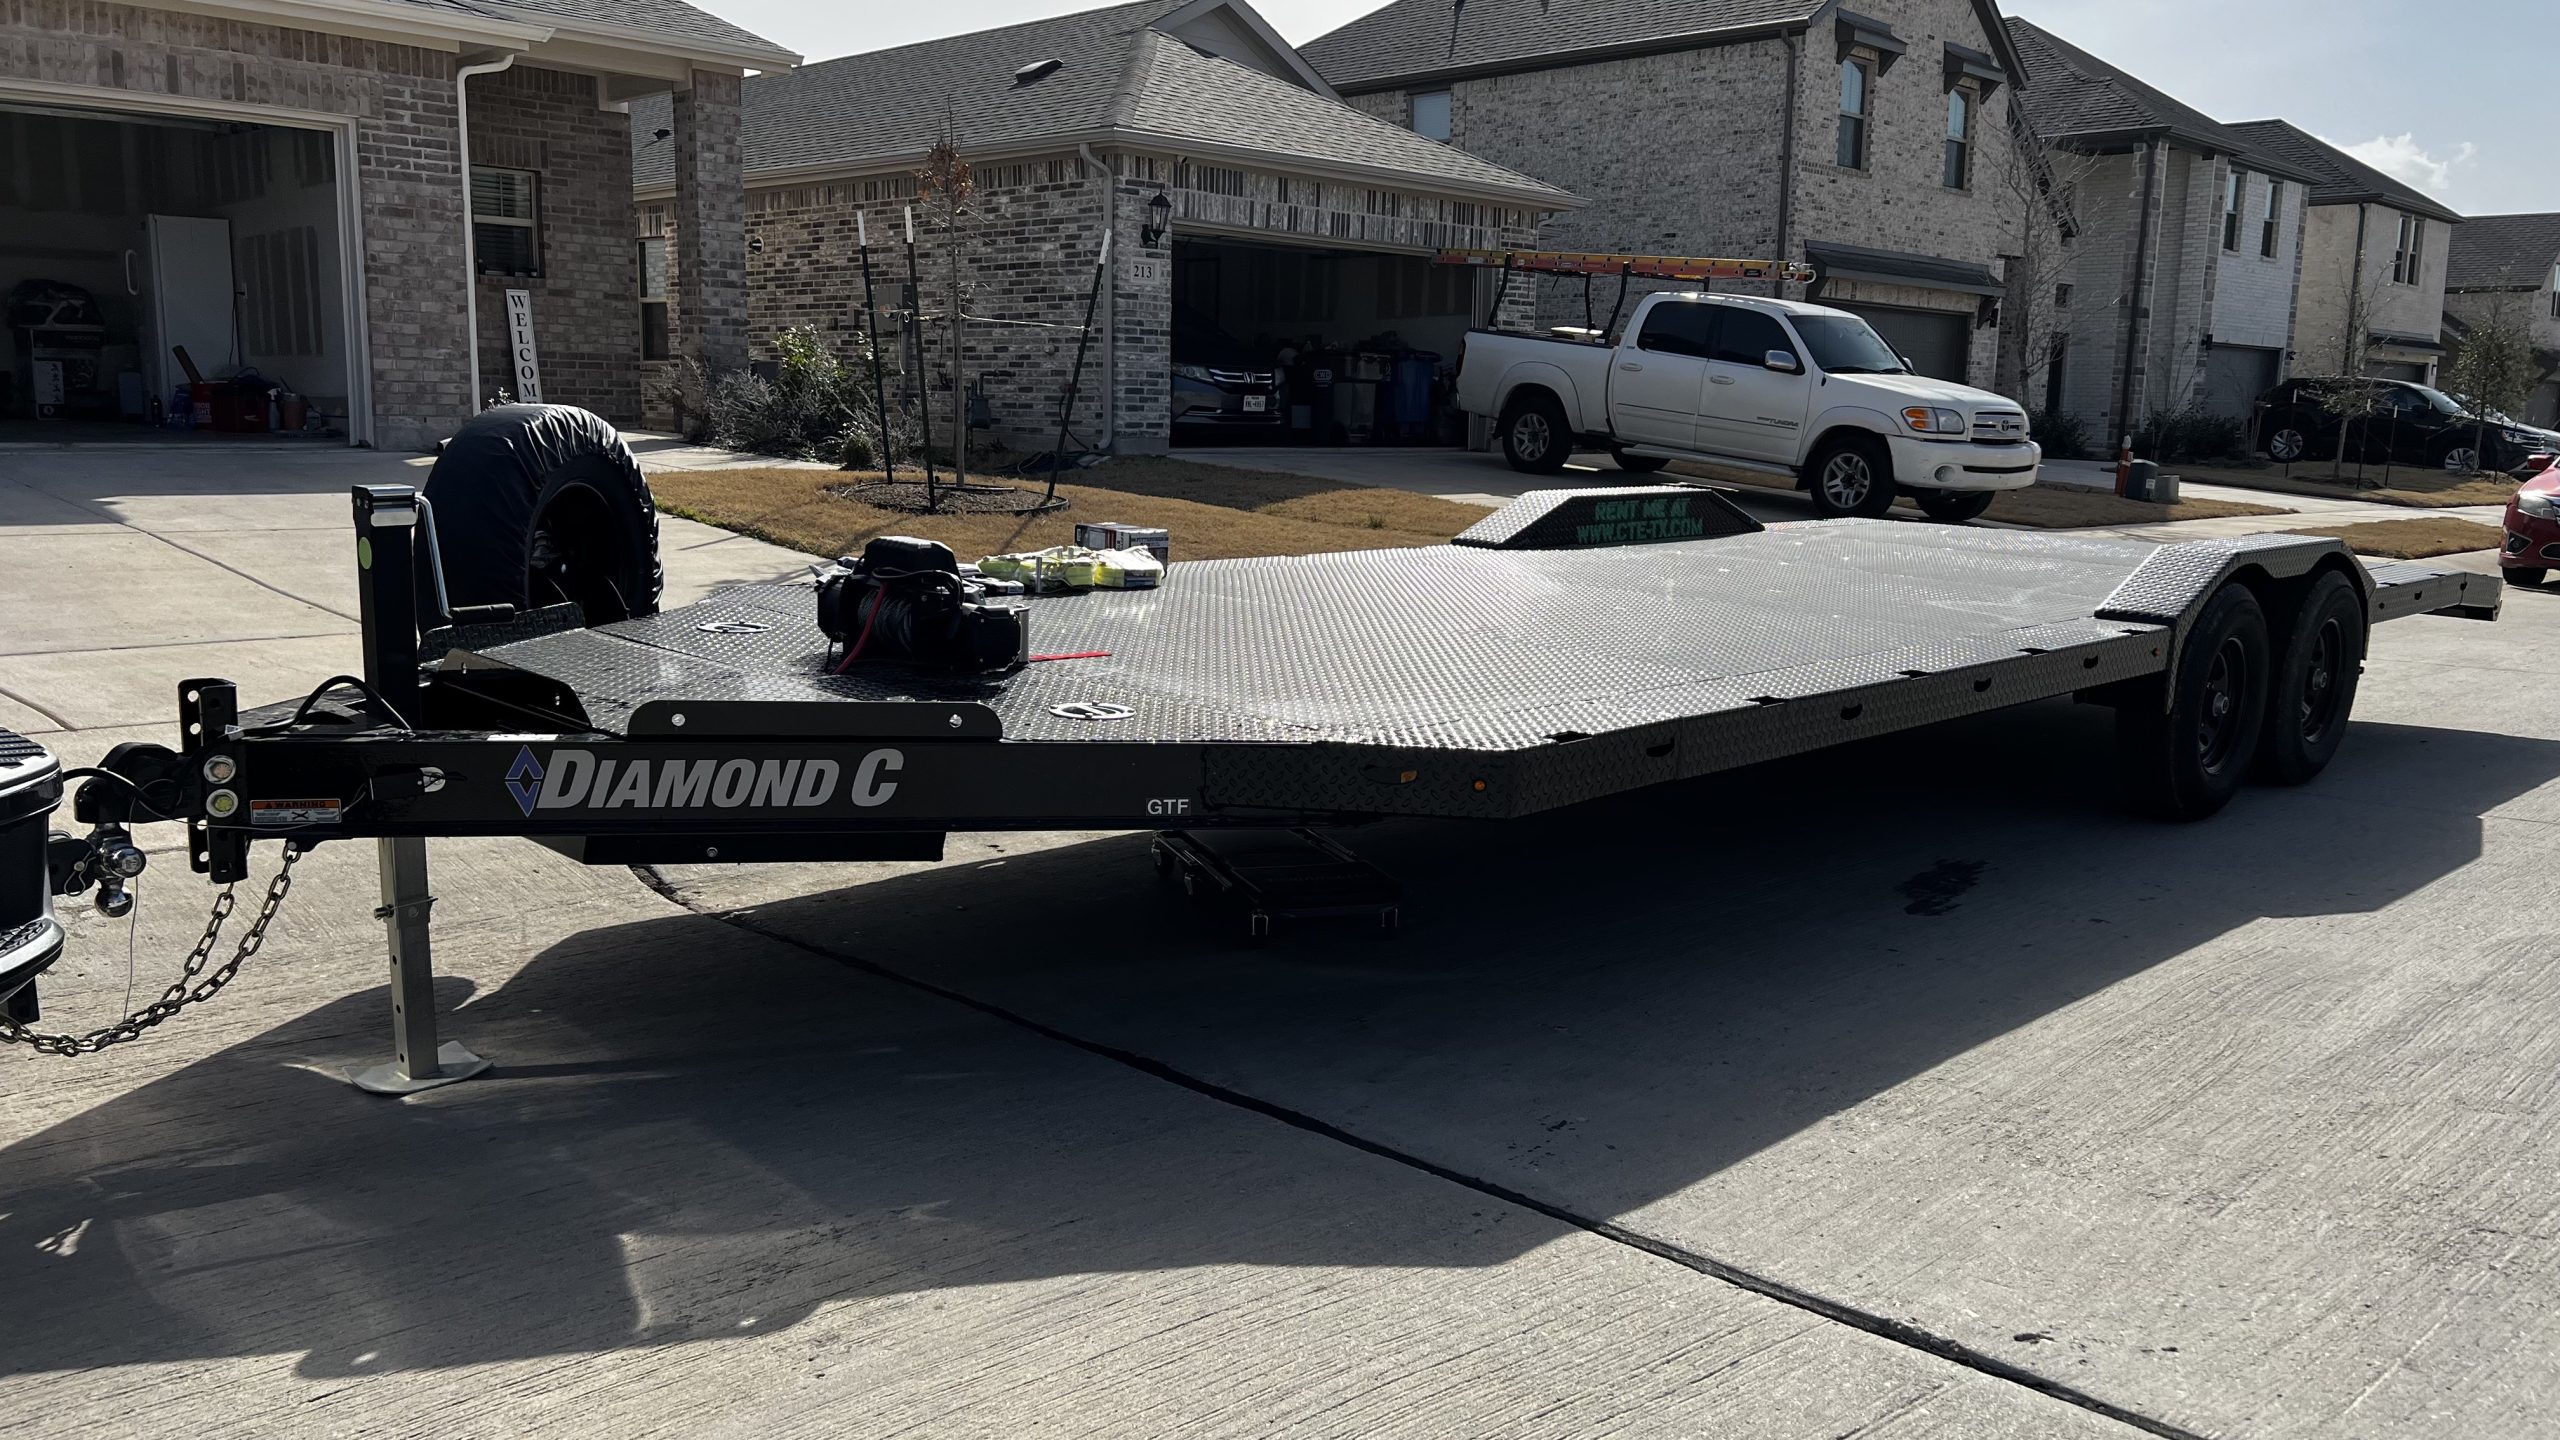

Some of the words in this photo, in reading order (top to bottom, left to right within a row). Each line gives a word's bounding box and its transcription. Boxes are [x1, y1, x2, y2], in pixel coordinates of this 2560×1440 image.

[1133, 265, 1152, 278] 213
[510, 295, 537, 404] WELCOM
[1594, 500, 1640, 521] RENT
[1642, 498, 1668, 518] ME
[1670, 497, 1692, 517] AT
[1577, 518, 1703, 543] WWW.CTE-TX.COM
[536, 749, 840, 809] DIAMOND
[851, 748, 905, 808] C
[1147, 799, 1189, 815] GTF
